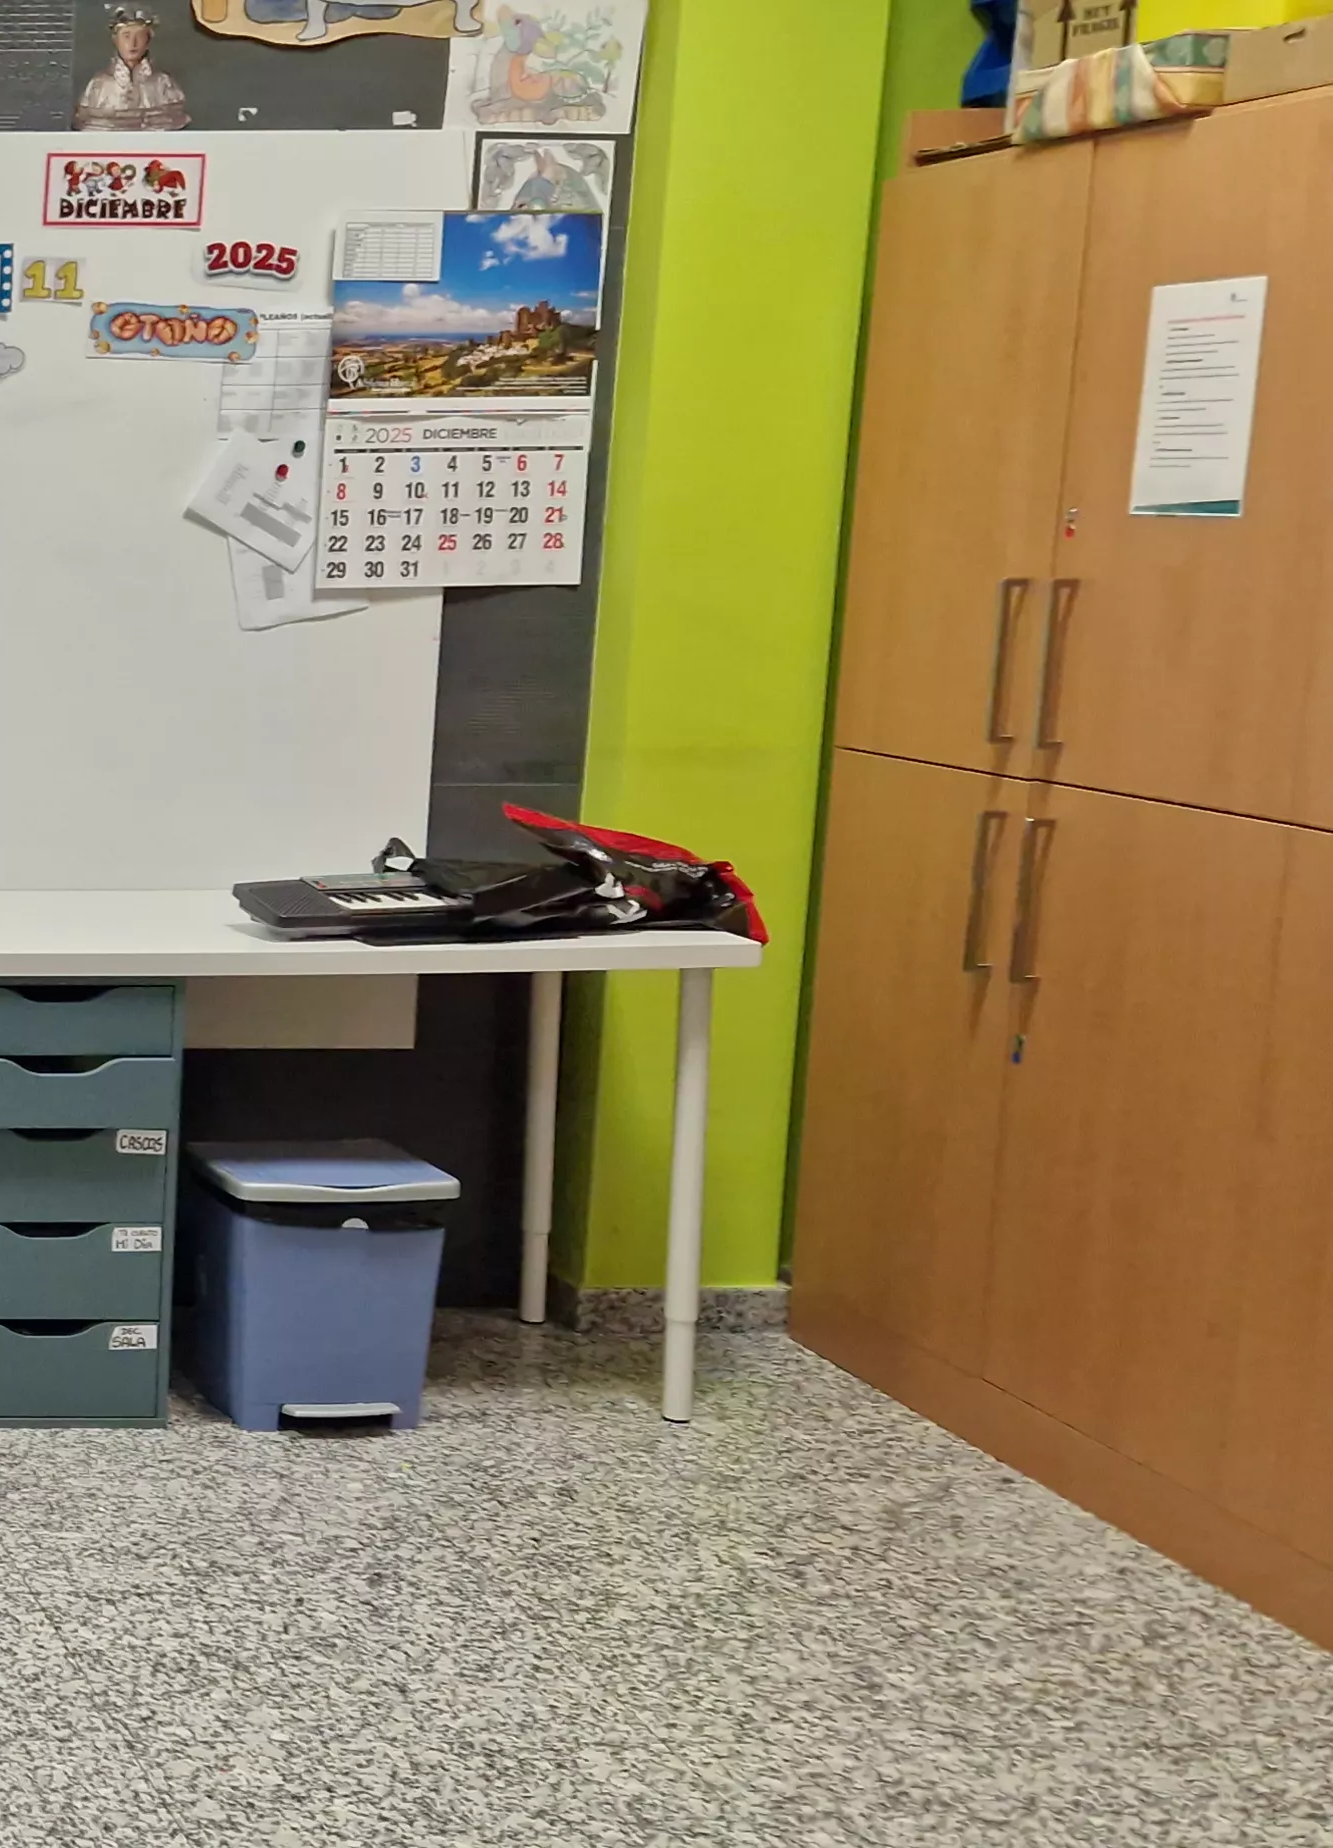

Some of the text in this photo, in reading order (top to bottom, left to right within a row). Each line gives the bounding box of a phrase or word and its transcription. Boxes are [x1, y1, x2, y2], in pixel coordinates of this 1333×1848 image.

[59, 197, 188, 220] DICIEMBRE
[205, 241, 299, 275] 2025
[23, 260, 84, 300] 11
[109, 310, 238, 346] OTOÑO
[365, 428, 498, 443] 2025 DICIEMBRE
[339, 457, 347, 472] 1
[374, 457, 385, 473] 2
[410, 456, 421, 472] 3
[447, 456, 458, 471] 4
[482, 455, 492, 471] 5
[517, 455, 527, 471] 6
[554, 455, 565, 470] 7
[336, 481, 567, 499] 8 9 10 11 12 13 14
[331, 507, 563, 526] 15 16 17 18 19 20 21
[328, 533, 562, 552] 22 23 24 25 26 27 28
[326, 562, 346, 578] 29
[364, 561, 384, 577] 30
[400, 561, 419, 577] 31
[112, 1337, 146, 1348] SALA
